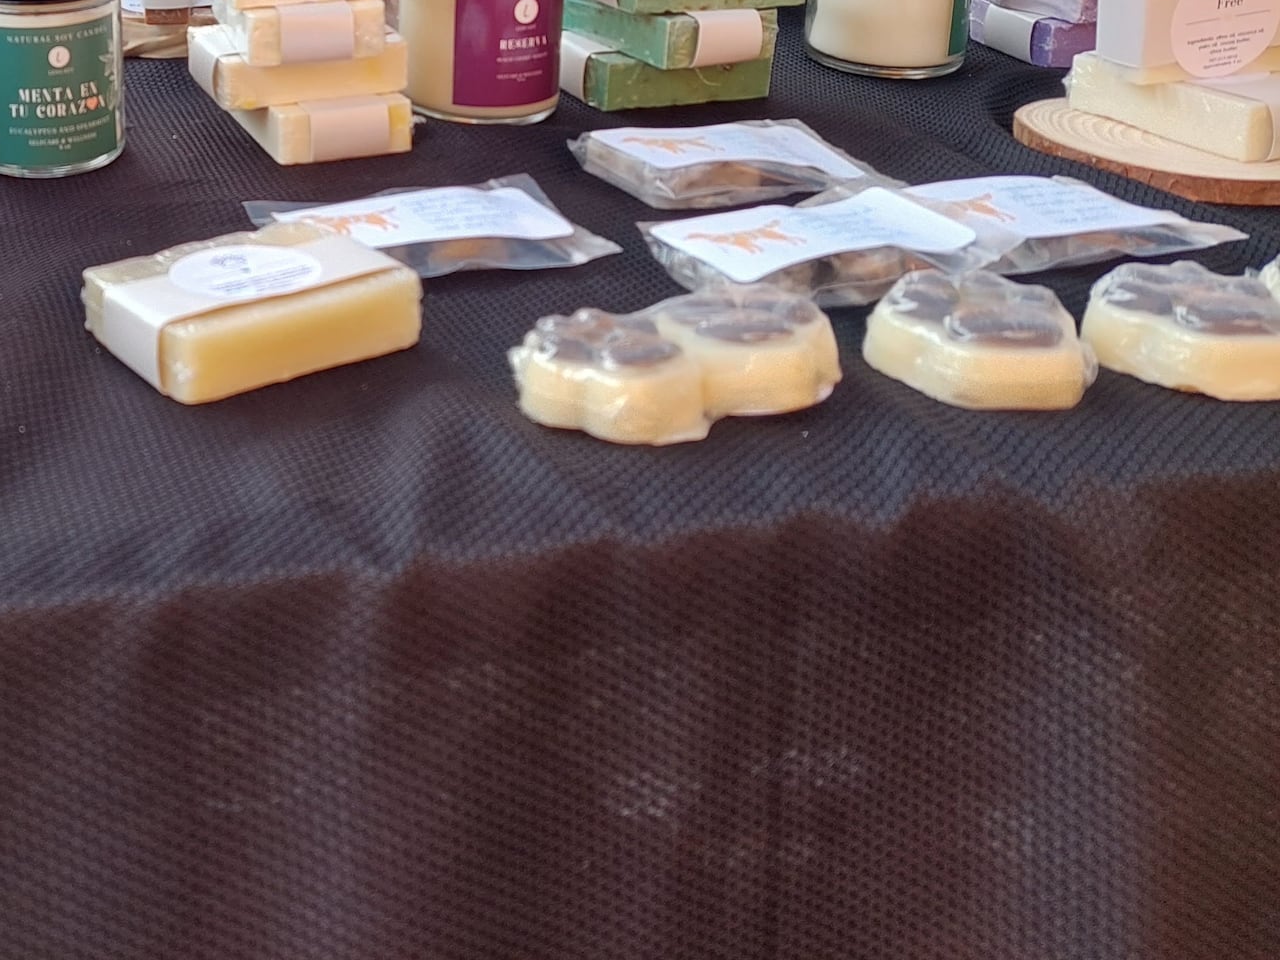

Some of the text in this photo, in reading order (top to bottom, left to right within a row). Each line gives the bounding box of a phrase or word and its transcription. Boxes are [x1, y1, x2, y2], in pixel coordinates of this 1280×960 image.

[6, 35, 51, 44] NATURAL
[55, 33, 73, 43] SOY
[18, 81, 98, 103] MENTA EN
[9, 103, 29, 118] TU
[59, 124, 75, 134] AND
